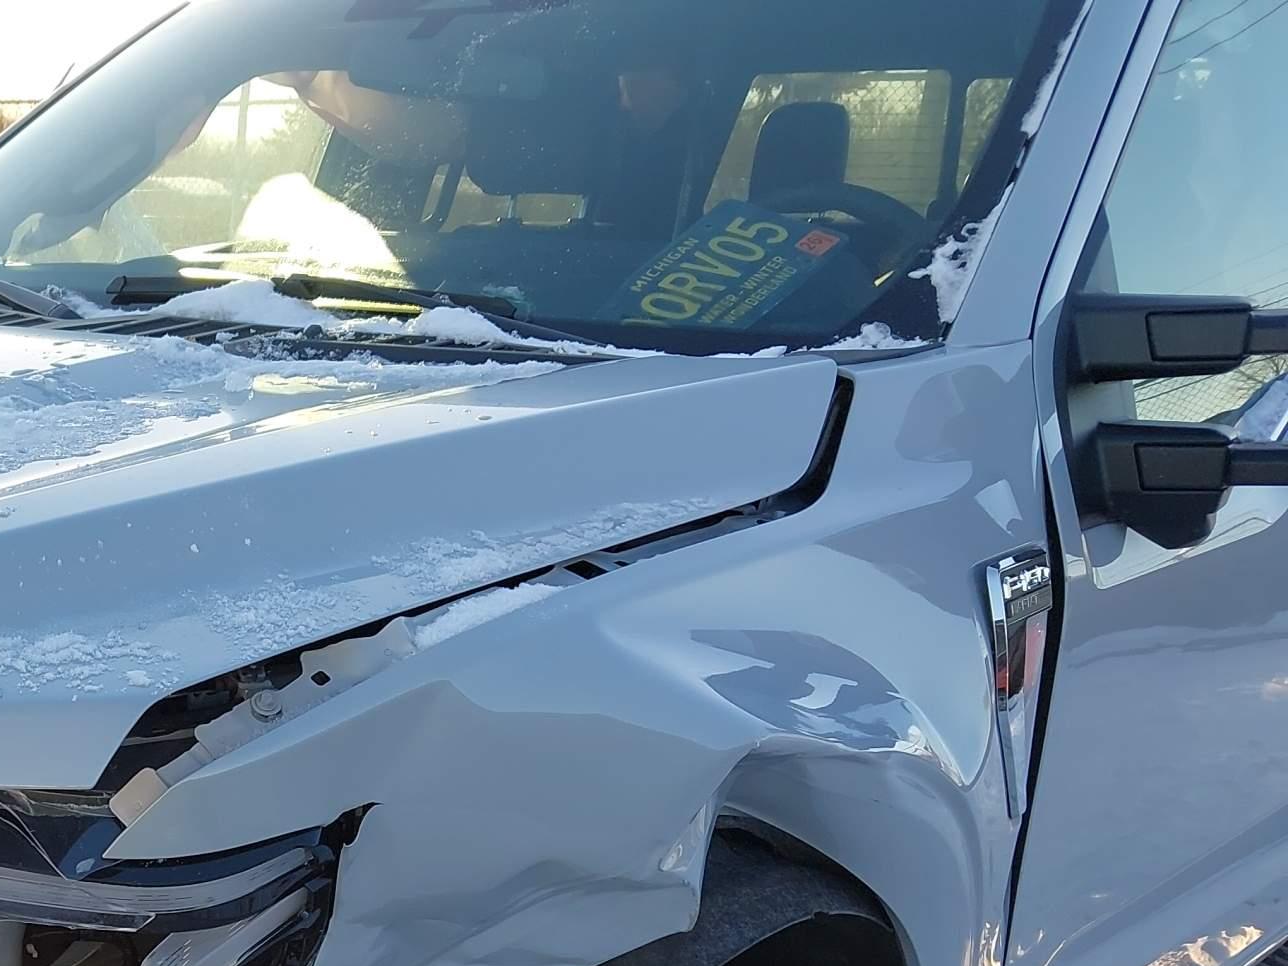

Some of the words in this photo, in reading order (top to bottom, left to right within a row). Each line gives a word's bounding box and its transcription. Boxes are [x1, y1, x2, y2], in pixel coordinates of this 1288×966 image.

[630, 237, 700, 292] MICHIGAN
[743, 255, 787, 290] WINTER
[722, 265, 798, 325] WONDERLAND
